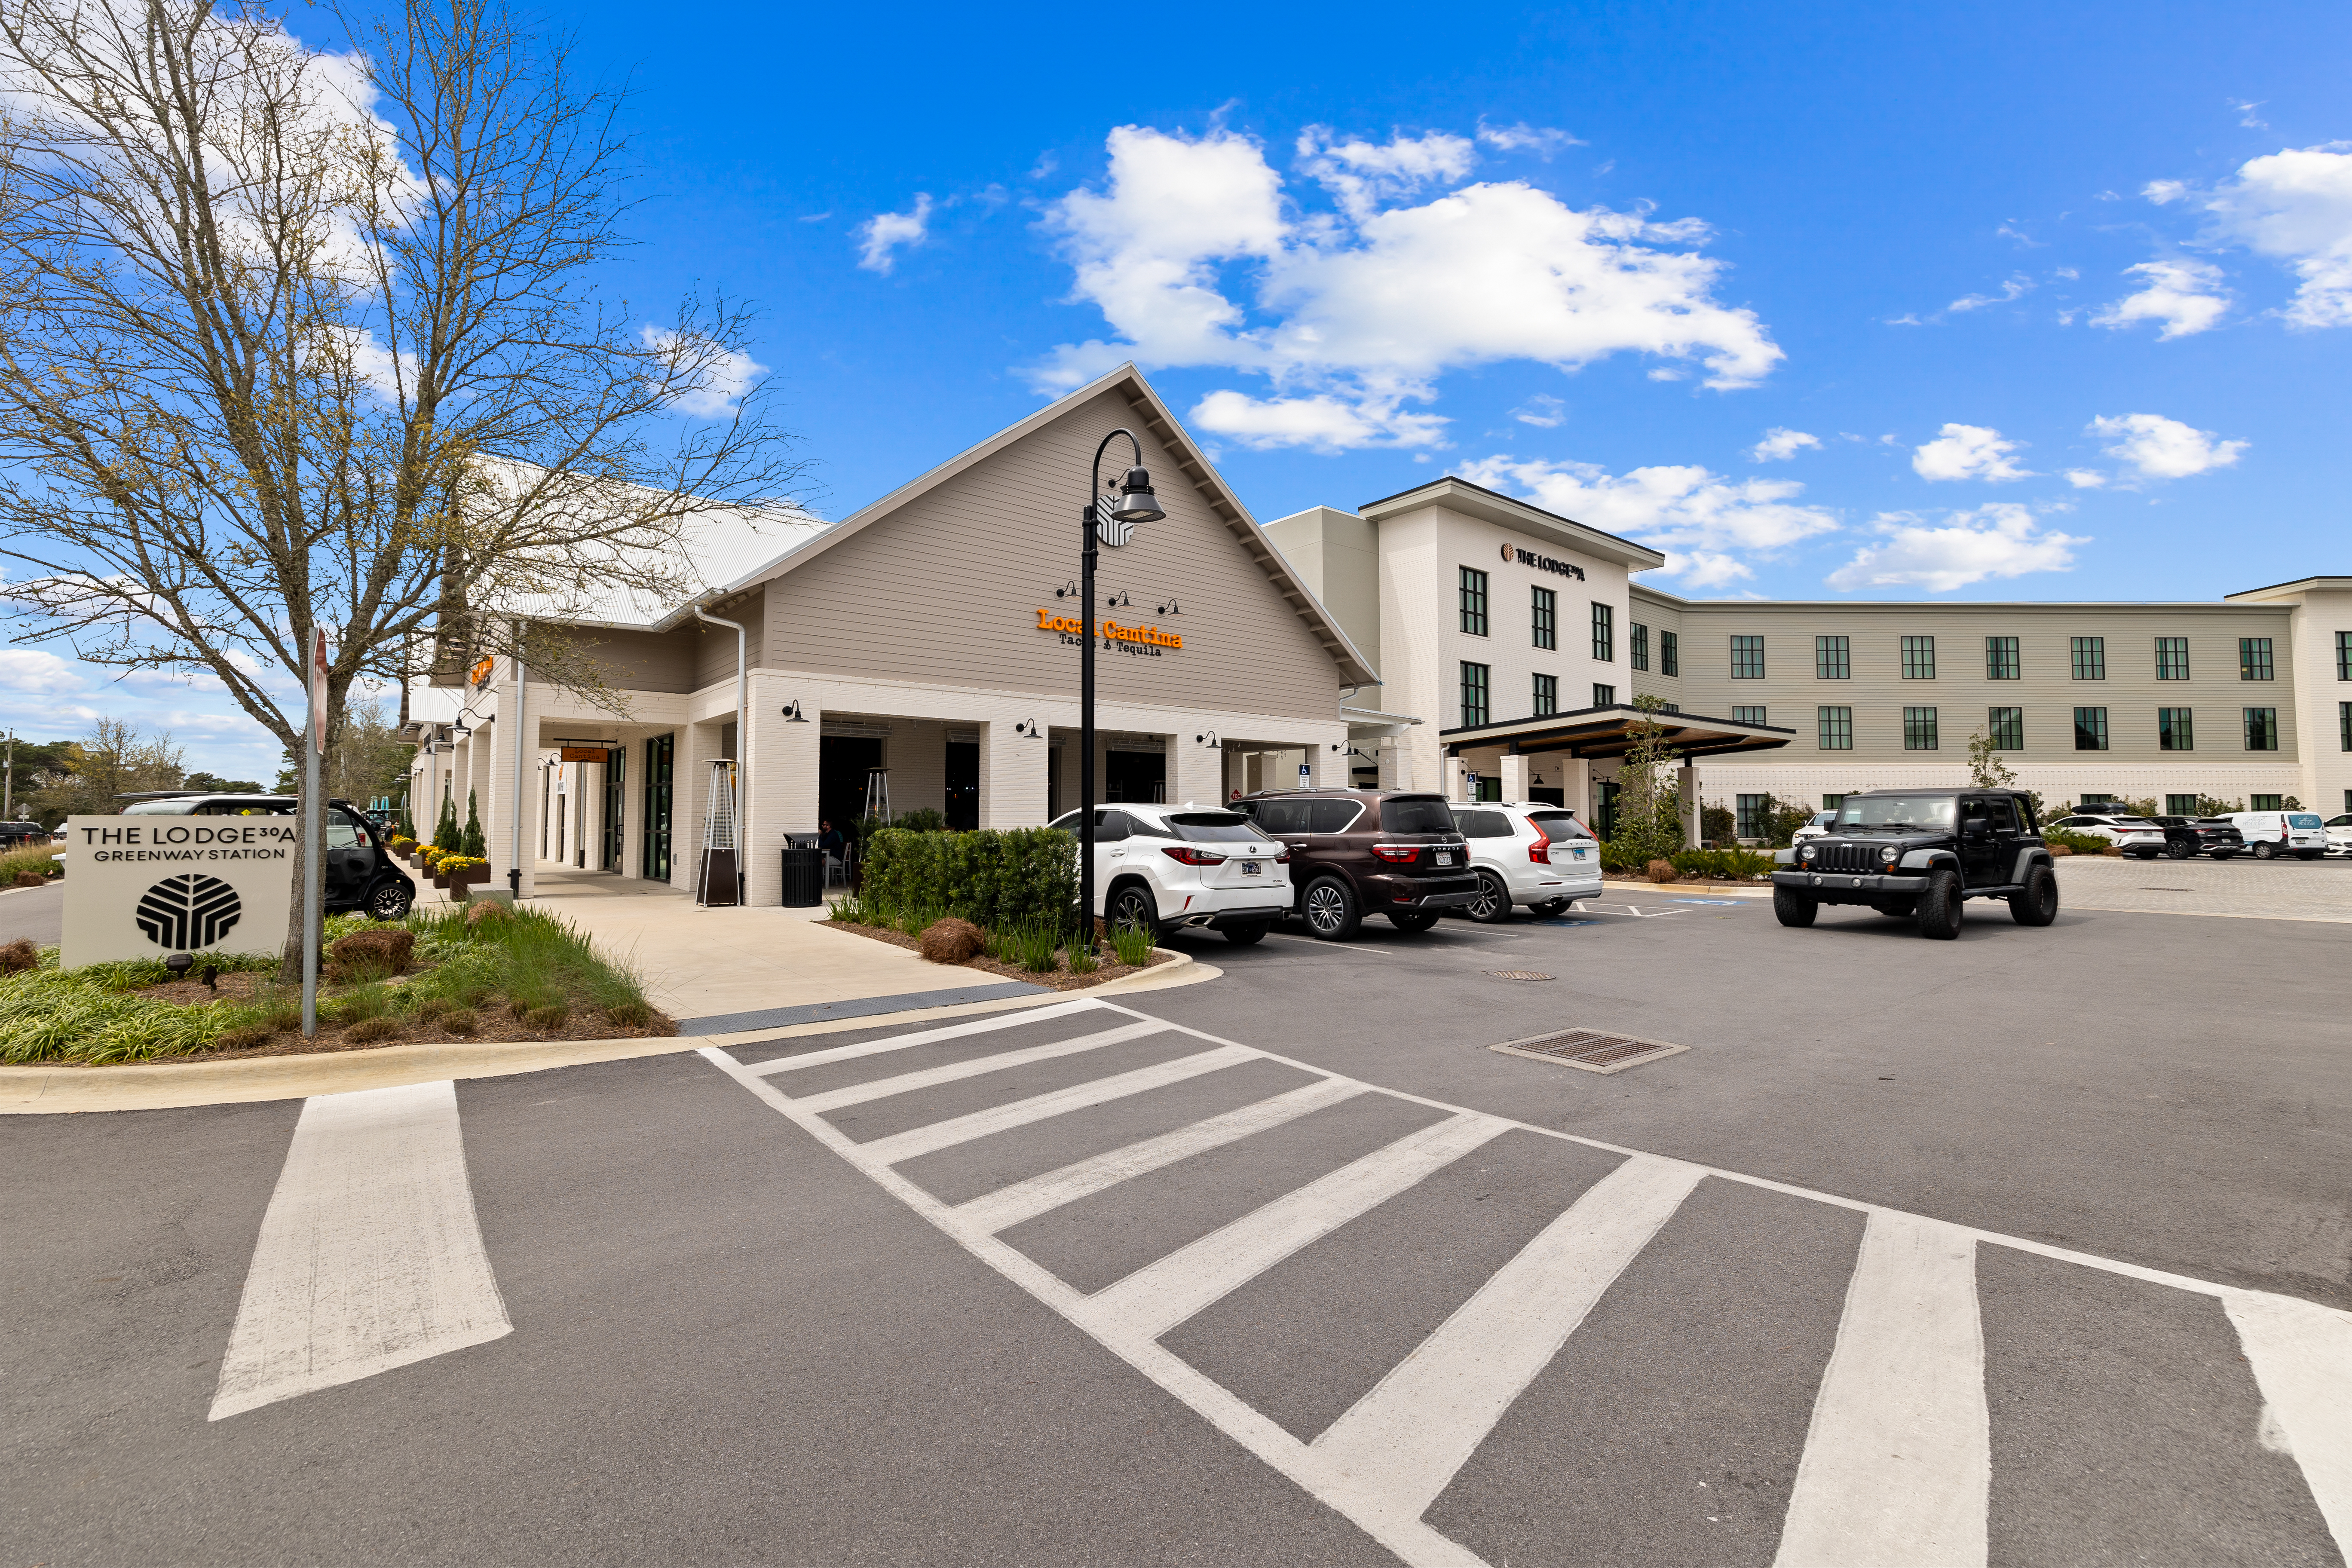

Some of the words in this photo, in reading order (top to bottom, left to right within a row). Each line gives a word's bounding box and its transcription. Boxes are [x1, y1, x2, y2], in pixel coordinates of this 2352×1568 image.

[1516, 548, 1537, 567] THE
[1103, 621, 1183, 648] Cantina
[1060, 633, 1096, 648] Tac
[1103, 640, 1111, 649] &
[1117, 641, 1161, 656] Tequila
[81, 827, 141, 845] THE
[94, 850, 205, 861] GREENWAY
[208, 849, 285, 860] STATION
